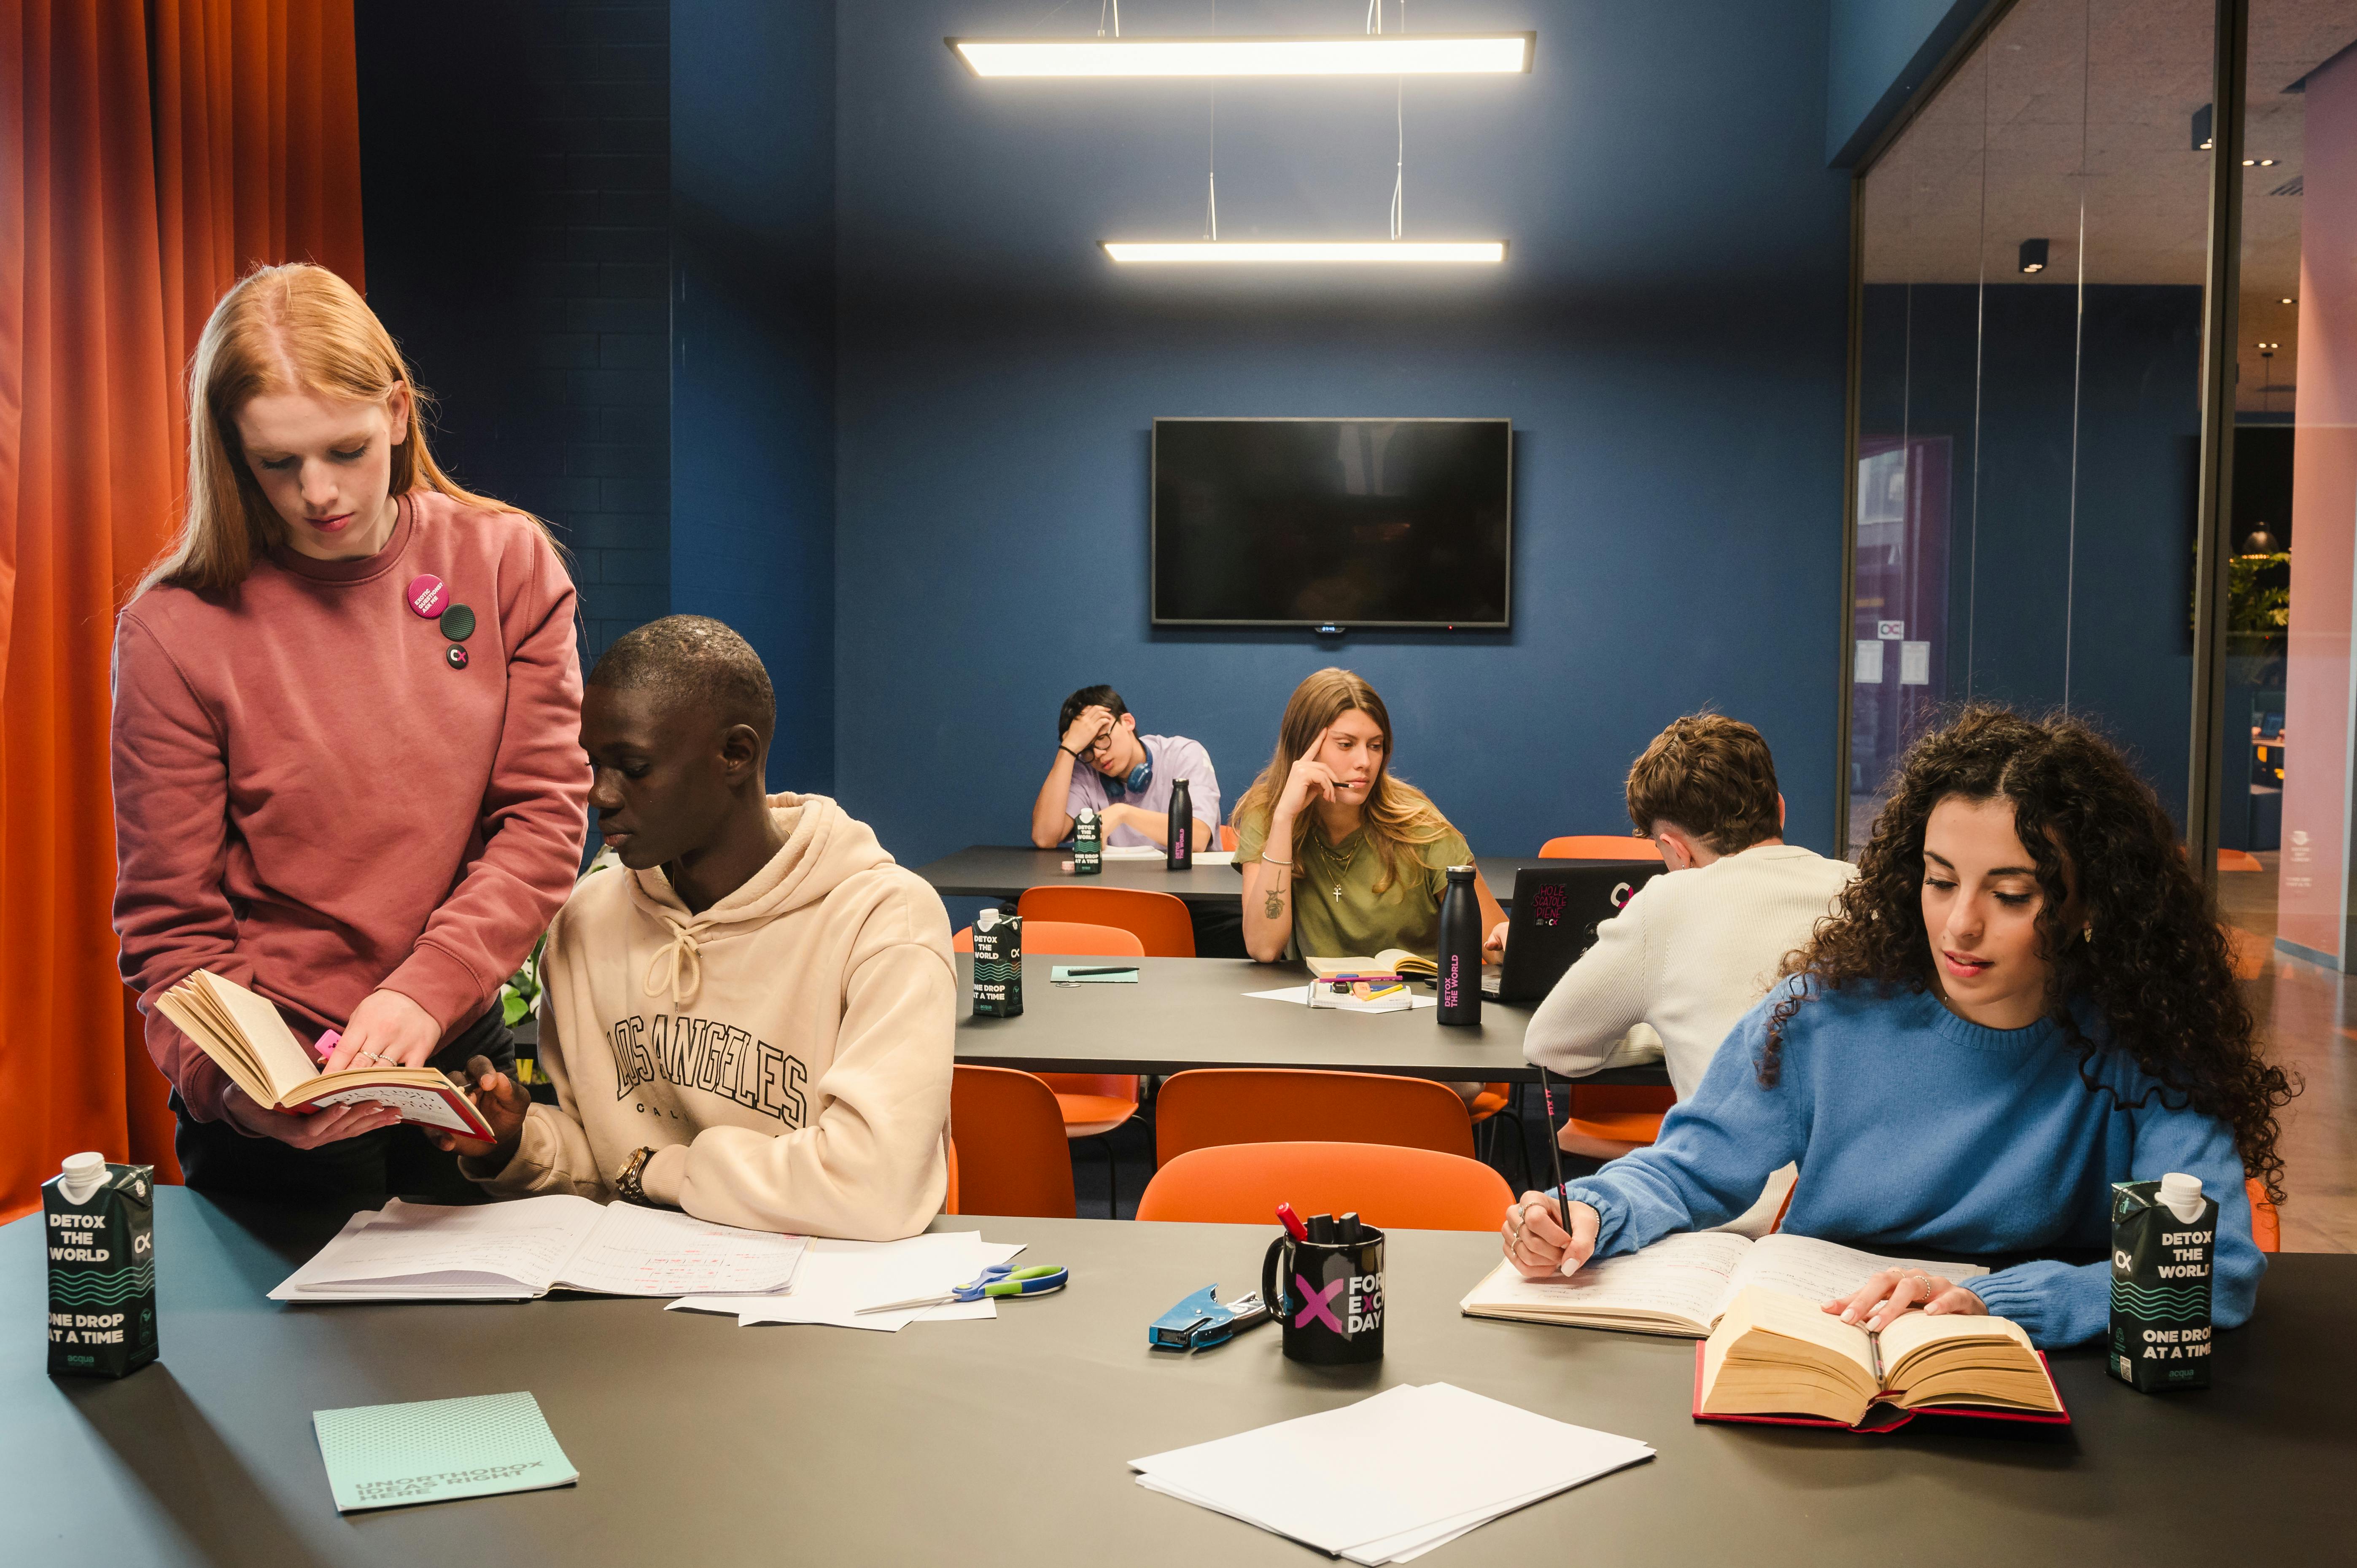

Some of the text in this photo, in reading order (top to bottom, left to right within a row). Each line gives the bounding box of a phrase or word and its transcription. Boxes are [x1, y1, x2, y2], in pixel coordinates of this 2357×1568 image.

[415, 589, 430, 605] EXOTIC
[418, 582, 443, 609] QUESTIONS?
[422, 595, 439, 613] ASK ME
[1533, 895, 1567, 906] SCATOLE
[1537, 907, 1563, 918] PIENE
[607, 1014, 807, 1129] LOS ANGELES
[1545, 1089, 1552, 1098] IT
[50, 1214, 106, 1229] DETOX
[61, 1231, 93, 1245] THE
[2162, 1231, 2212, 1245] DETOX
[49, 1247, 110, 1262] WORLD
[2173, 1248, 2203, 1261] THE
[76, 1313, 124, 1328] DROP
[1348, 1310, 1381, 1333] DAY
[66, 1330, 79, 1343] A
[81, 1329, 124, 1344] TIME
[2143, 1329, 2179, 1343] ONE
[67, 1355, 94, 1364] acqua
[2143, 1346, 2168, 1359] AT
[2170, 1346, 2182, 1358] A
[2169, 1369, 2194, 1377] acqua
[355, 1460, 544, 1489] UNORTHODOX
[358, 1470, 525, 1495] IDEAS RIGHT
[360, 1488, 431, 1501] HERE
